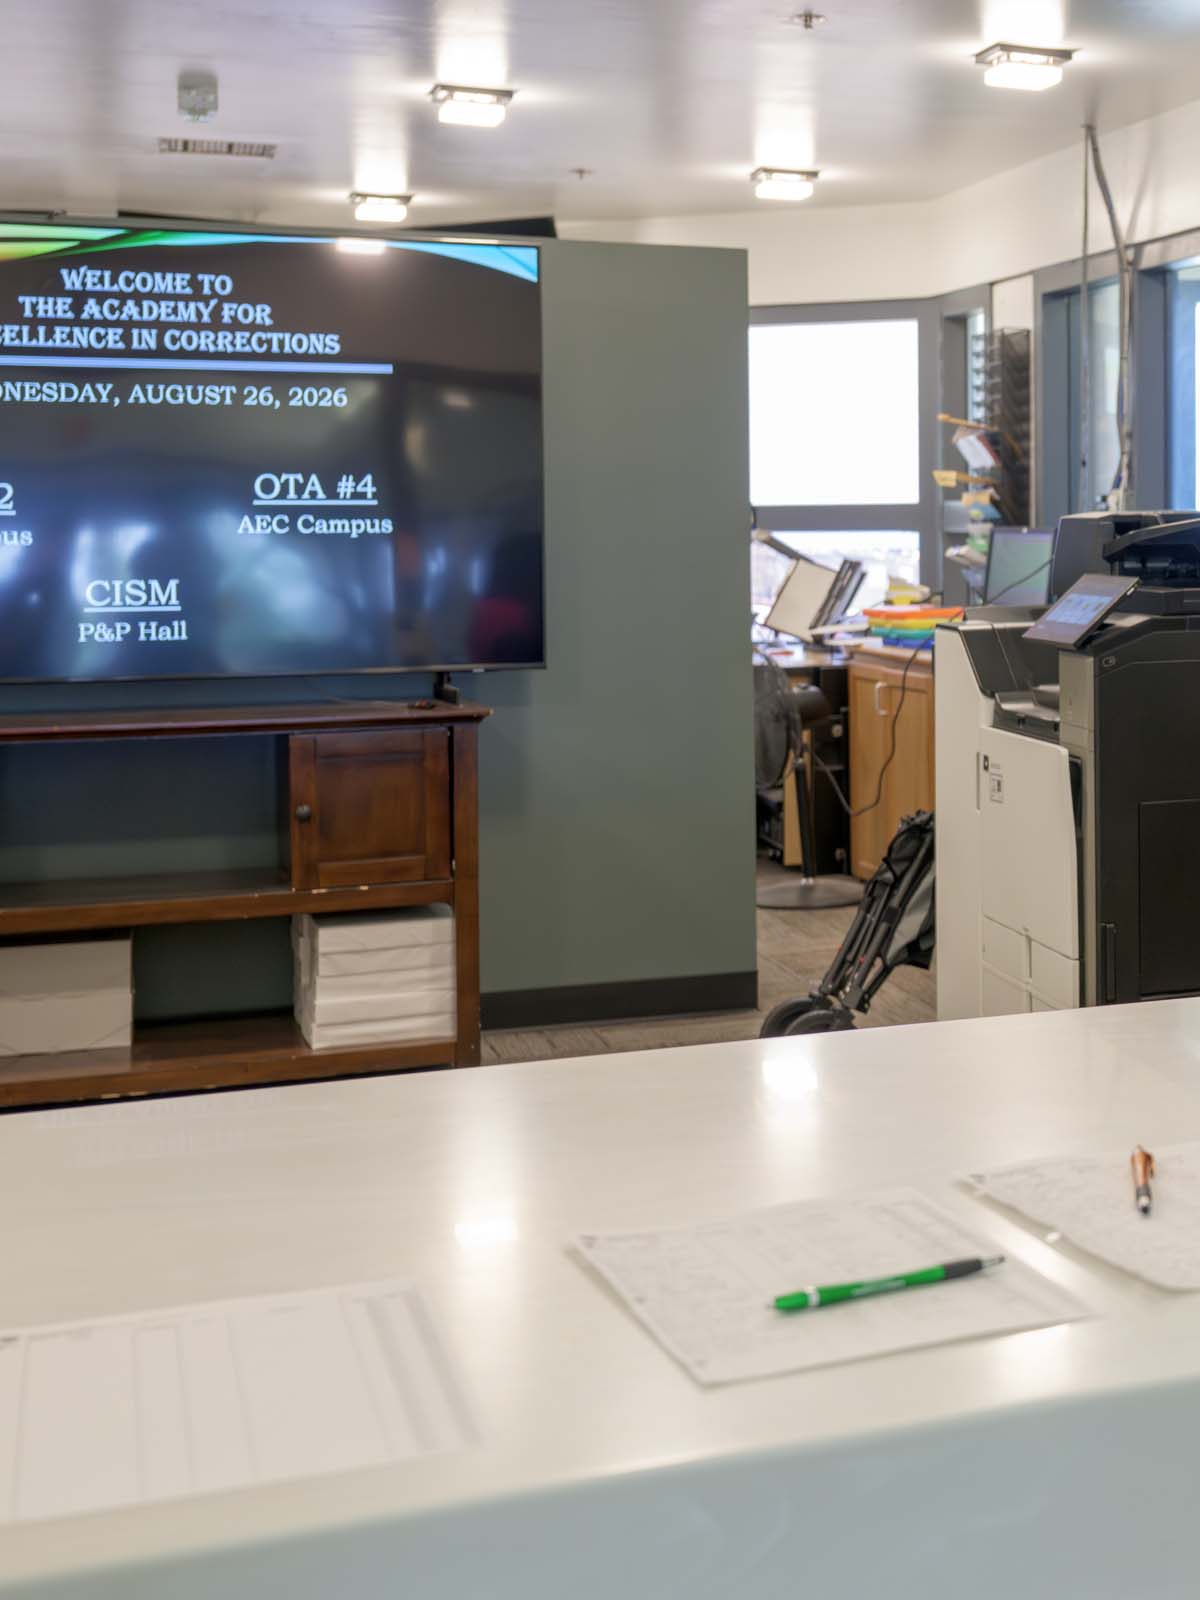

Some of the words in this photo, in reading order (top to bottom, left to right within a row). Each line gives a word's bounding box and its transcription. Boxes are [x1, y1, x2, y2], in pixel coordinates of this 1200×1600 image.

[60, 265, 193, 294] WELCOME
[196, 273, 234, 296] TO
[18, 295, 76, 320] THE
[80, 298, 219, 324] ACADEMY
[221, 303, 274, 327] FOR
[0, 323, 126, 350] ELLENCE
[131, 327, 158, 351] IN
[163, 330, 342, 355] CORRECTIONS
[0, 381, 121, 408] NESDAY,
[127, 383, 237, 407] AUGUST
[243, 385, 281, 410] 26,
[288, 386, 349, 408] 2026
[253, 473, 327, 500] OTA
[336, 473, 378, 500] #4
[237, 514, 291, 535] AEC
[296, 514, 394, 540] Campus
[84, 578, 181, 607] CISM
[78, 622, 132, 643] P&P
[137, 619, 188, 642] Hall
